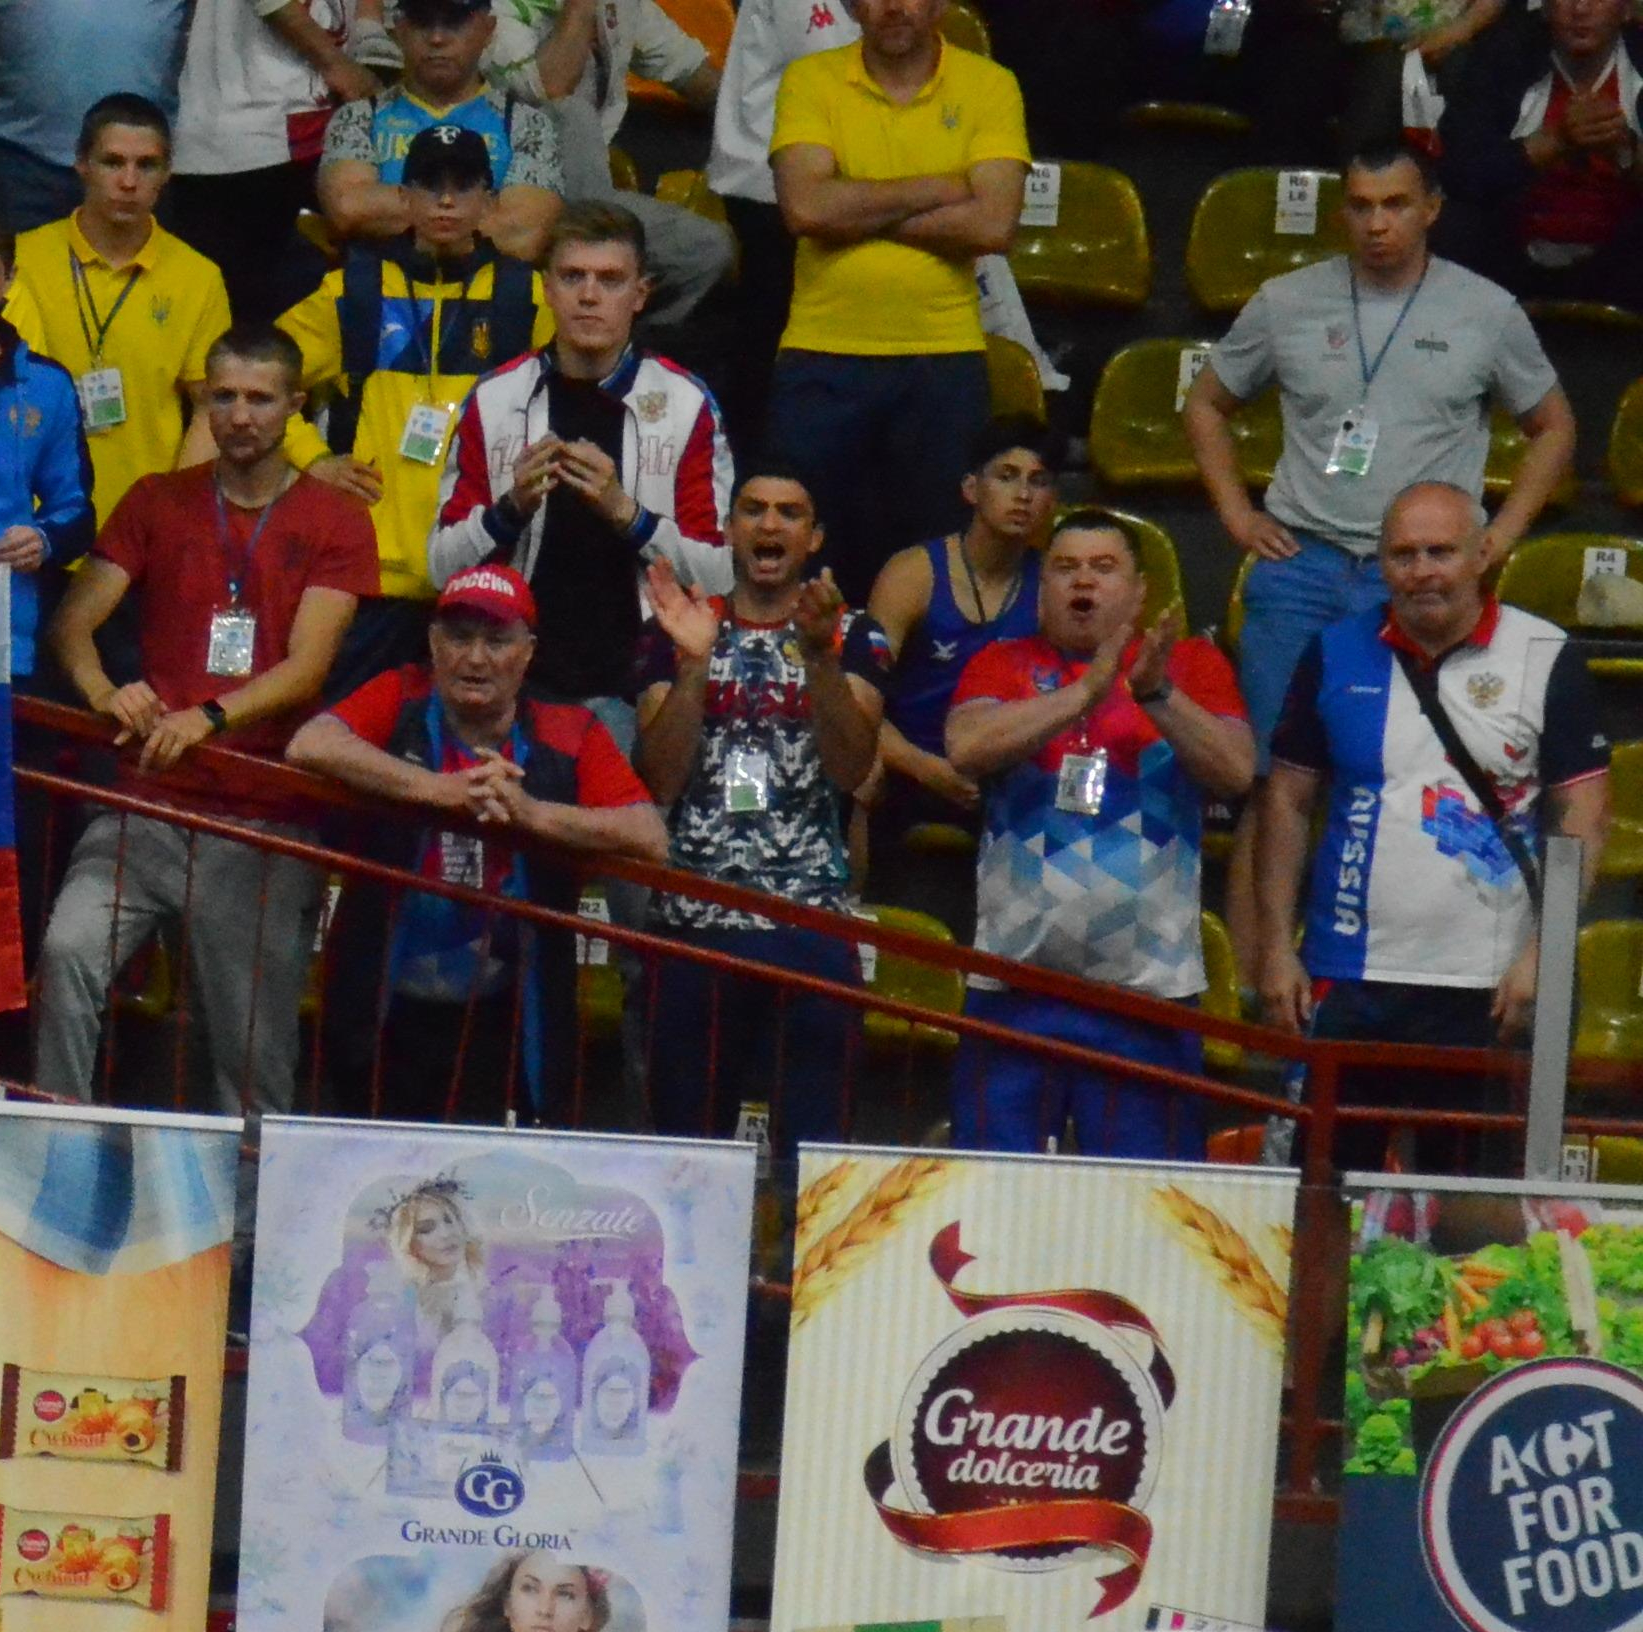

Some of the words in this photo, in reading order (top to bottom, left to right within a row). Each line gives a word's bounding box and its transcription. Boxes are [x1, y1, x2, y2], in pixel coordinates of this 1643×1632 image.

[924, 1388, 1132, 1456] Grande
[946, 1449, 1101, 1491] dolceria
[400, 1520, 489, 1548] GRANDE
[493, 1525, 572, 1552] GLORIA
[1507, 1474, 1623, 1552] FOR
[1502, 1530, 1643, 1617] FOOD
